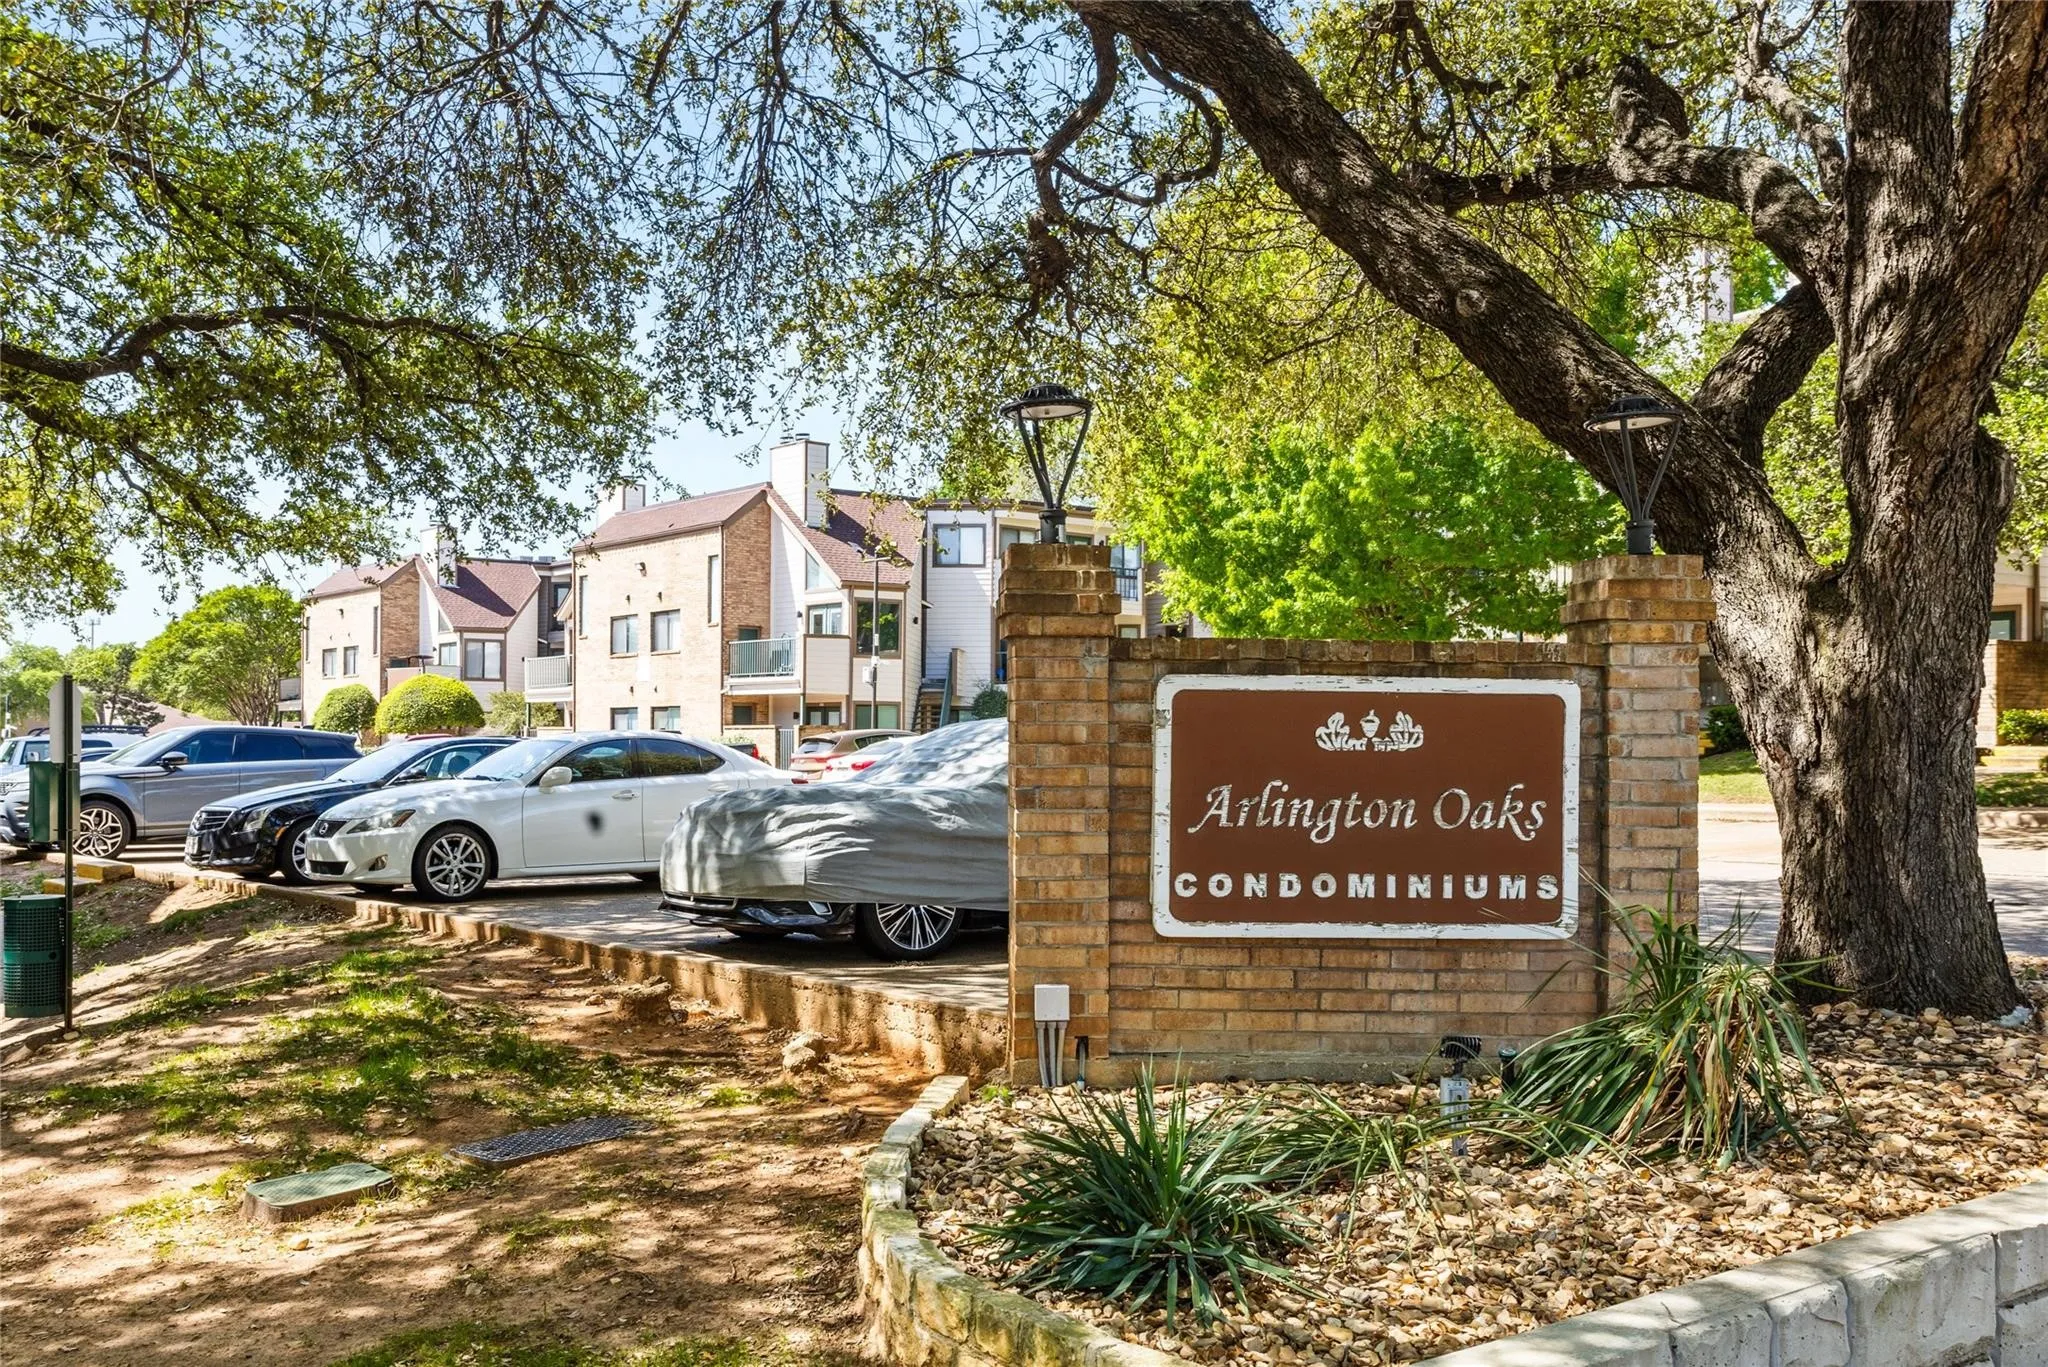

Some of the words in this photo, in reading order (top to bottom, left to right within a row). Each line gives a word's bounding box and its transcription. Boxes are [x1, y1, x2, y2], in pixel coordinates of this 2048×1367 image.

[1187, 779, 1418, 843] Arlington
[1432, 783, 1547, 841] Oaks
[1174, 872, 1560, 900] CONDOMINIUMS
